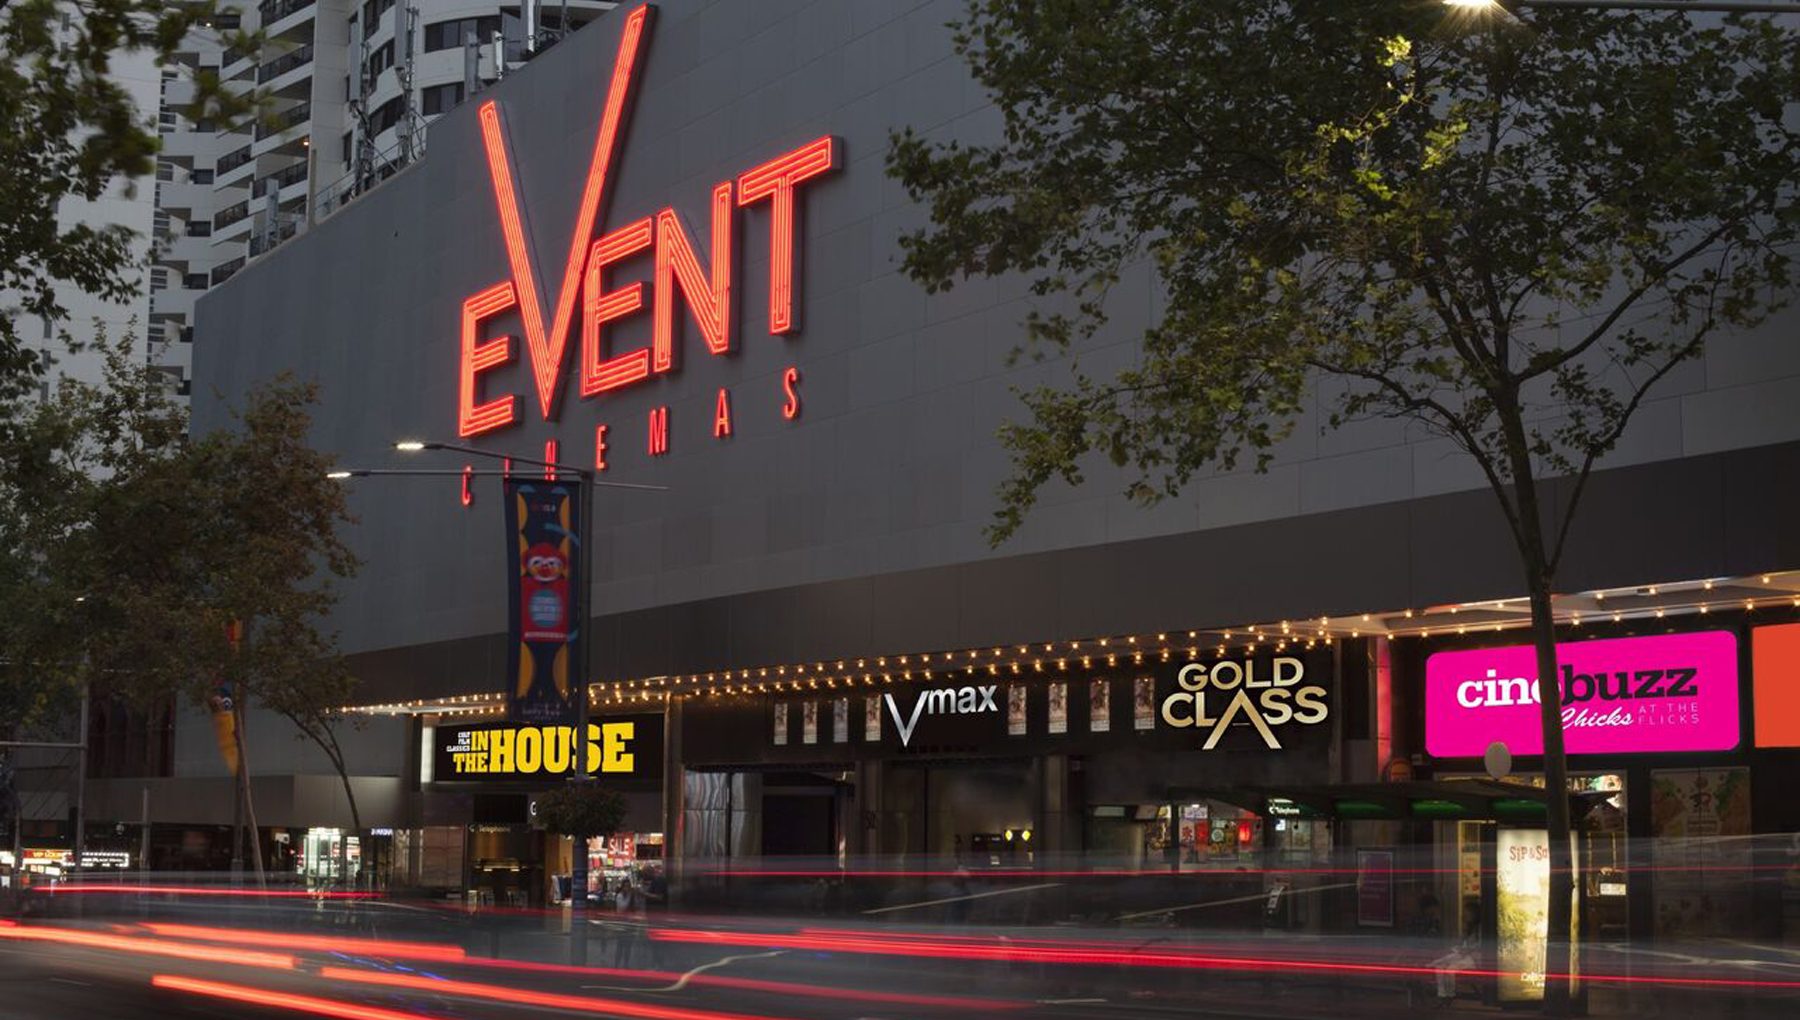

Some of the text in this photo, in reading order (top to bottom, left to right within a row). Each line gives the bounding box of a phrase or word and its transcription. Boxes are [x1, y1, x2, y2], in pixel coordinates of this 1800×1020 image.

[459, 3, 834, 438] EVENT
[460, 366, 800, 507] CINEMAS
[1177, 657, 1305, 692] GOLD
[884, 684, 998, 748] Vmax
[1161, 686, 1328, 750] CLASS
[1560, 706, 1634, 730] Chicks
[1637, 713, 1700, 726] FLICKS
[1638, 702, 1699, 714] AT THE
[471, 730, 489, 751] IN
[489, 721, 635, 773] HOUSE
[453, 752, 488, 773] THE
